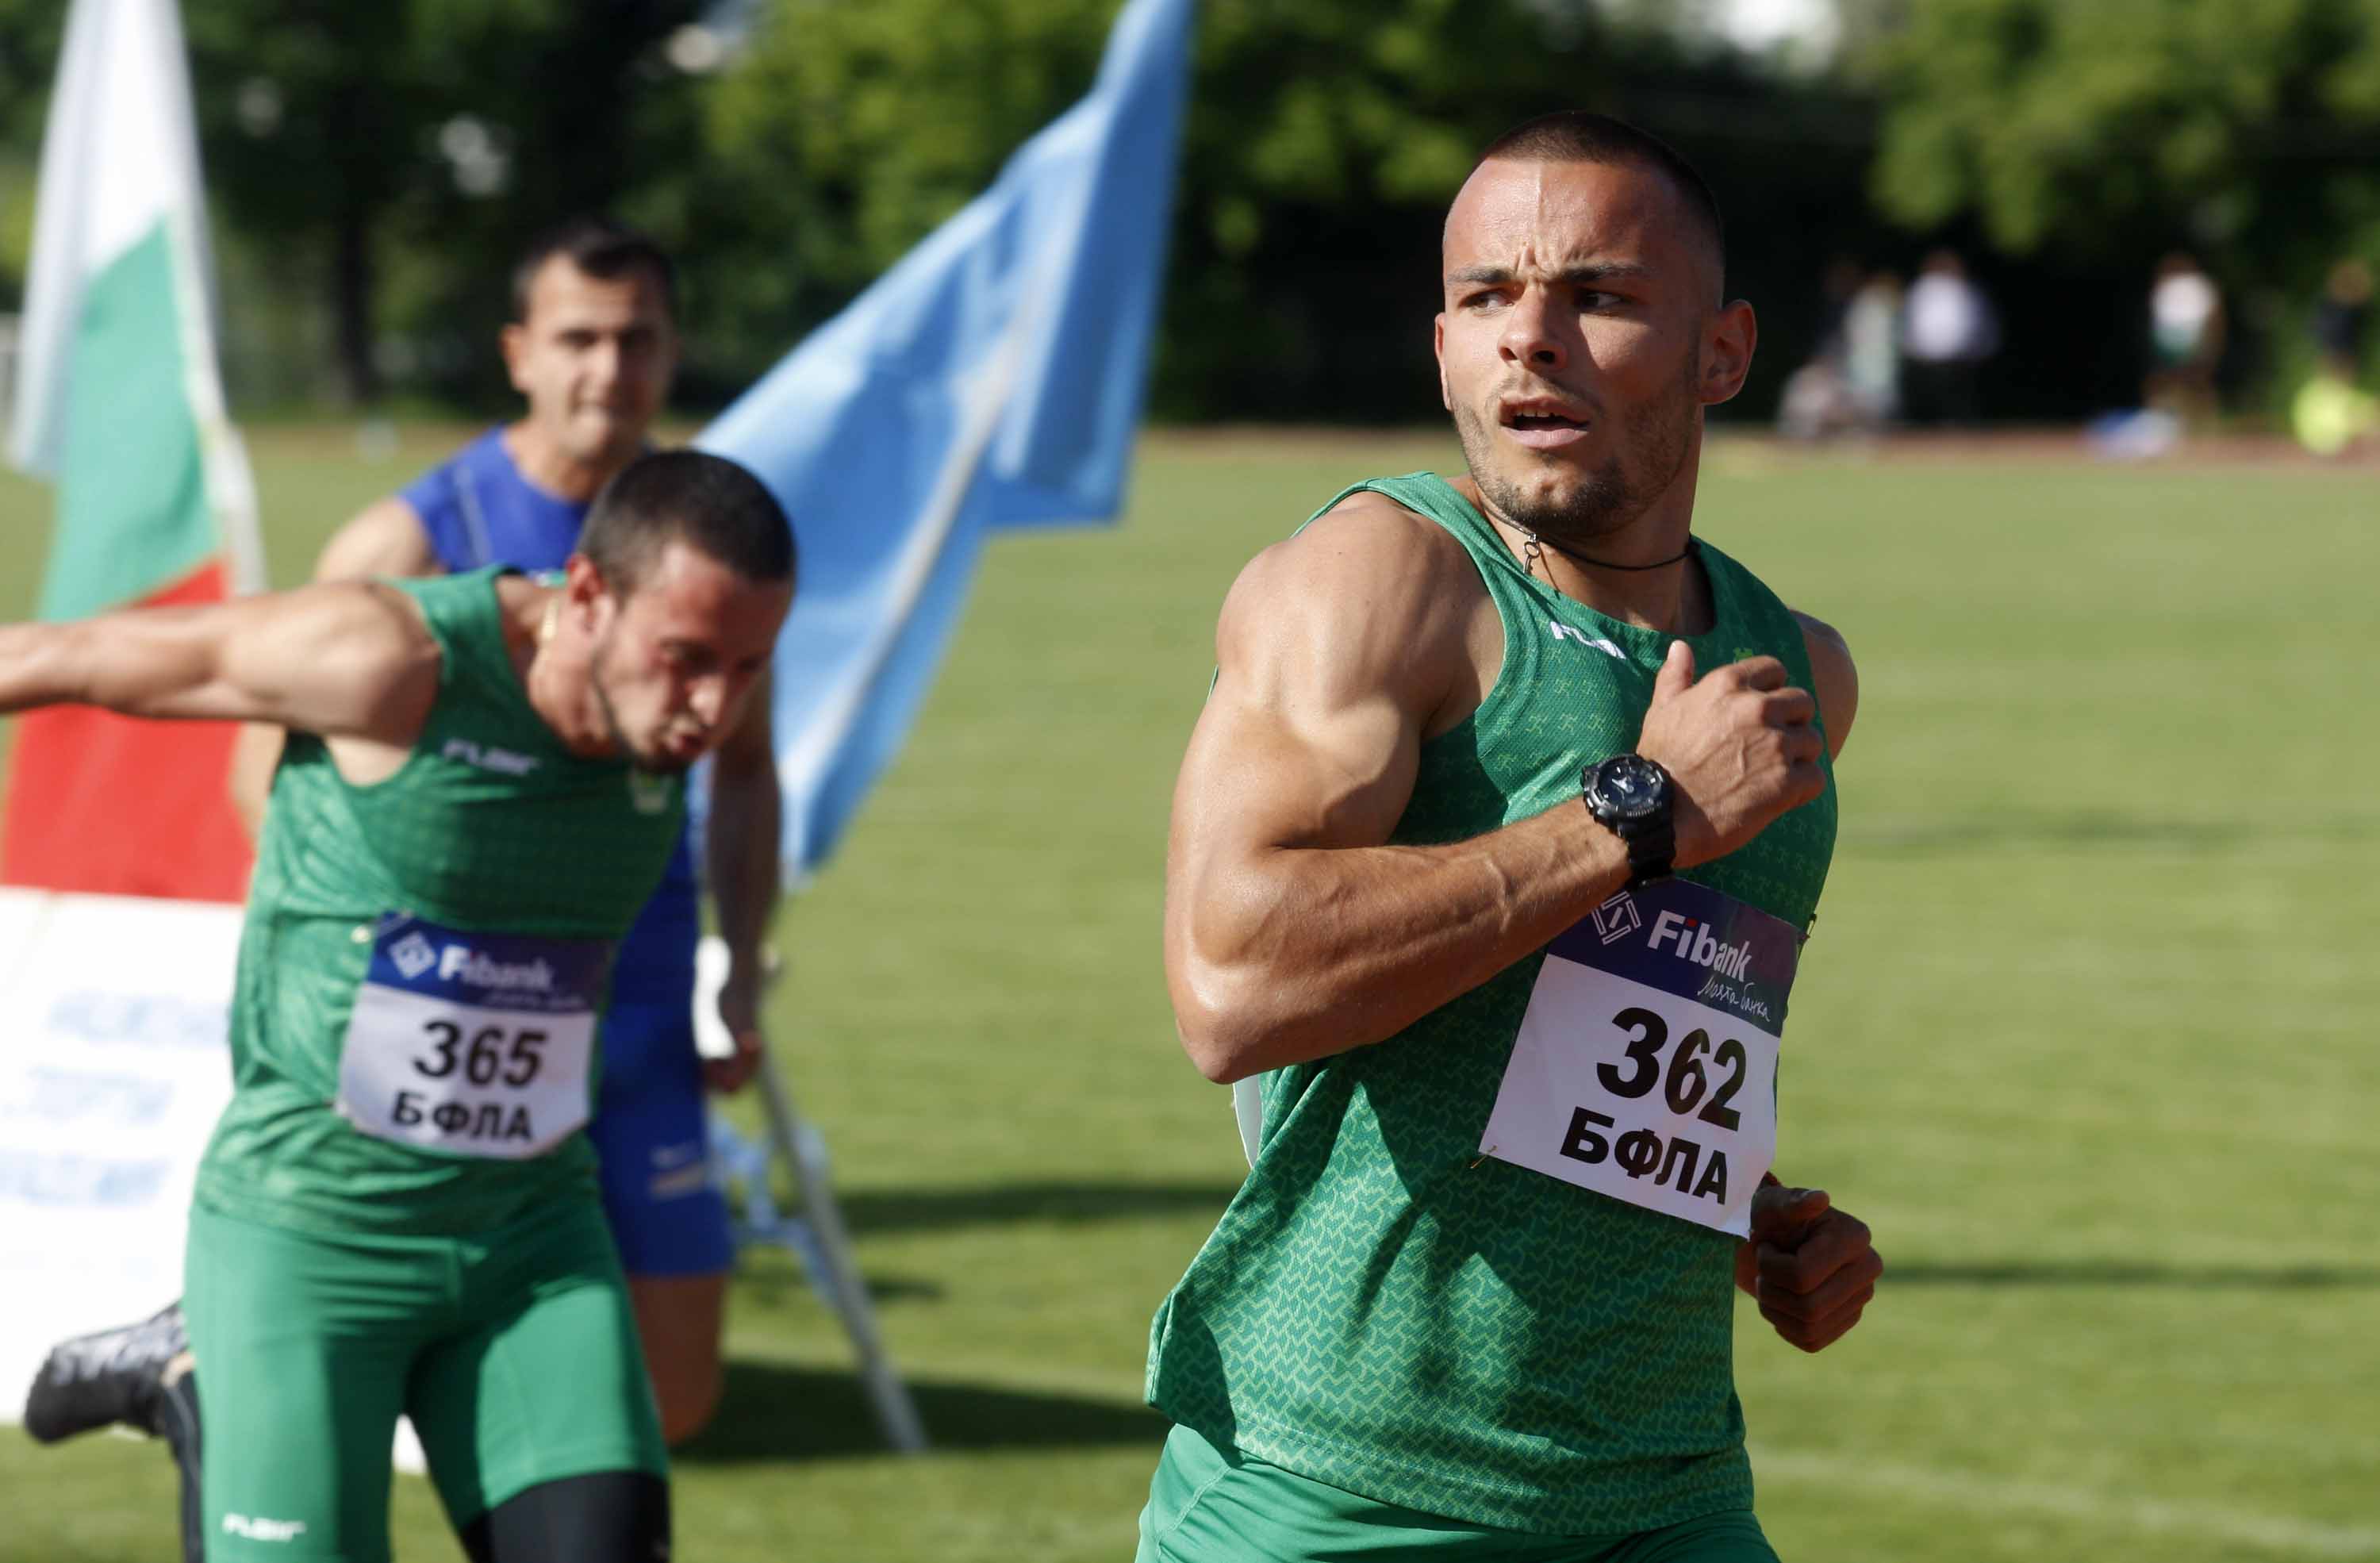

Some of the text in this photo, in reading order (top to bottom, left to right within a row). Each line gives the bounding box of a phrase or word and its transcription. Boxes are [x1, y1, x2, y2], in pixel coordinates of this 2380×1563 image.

[1647, 909, 1752, 982] Fibank
[413, 1020, 549, 1088] 365
[1596, 1008, 1746, 1132] 362
[391, 1091, 532, 1141] БФЛА
[1560, 1106, 1728, 1205] БФЛА
